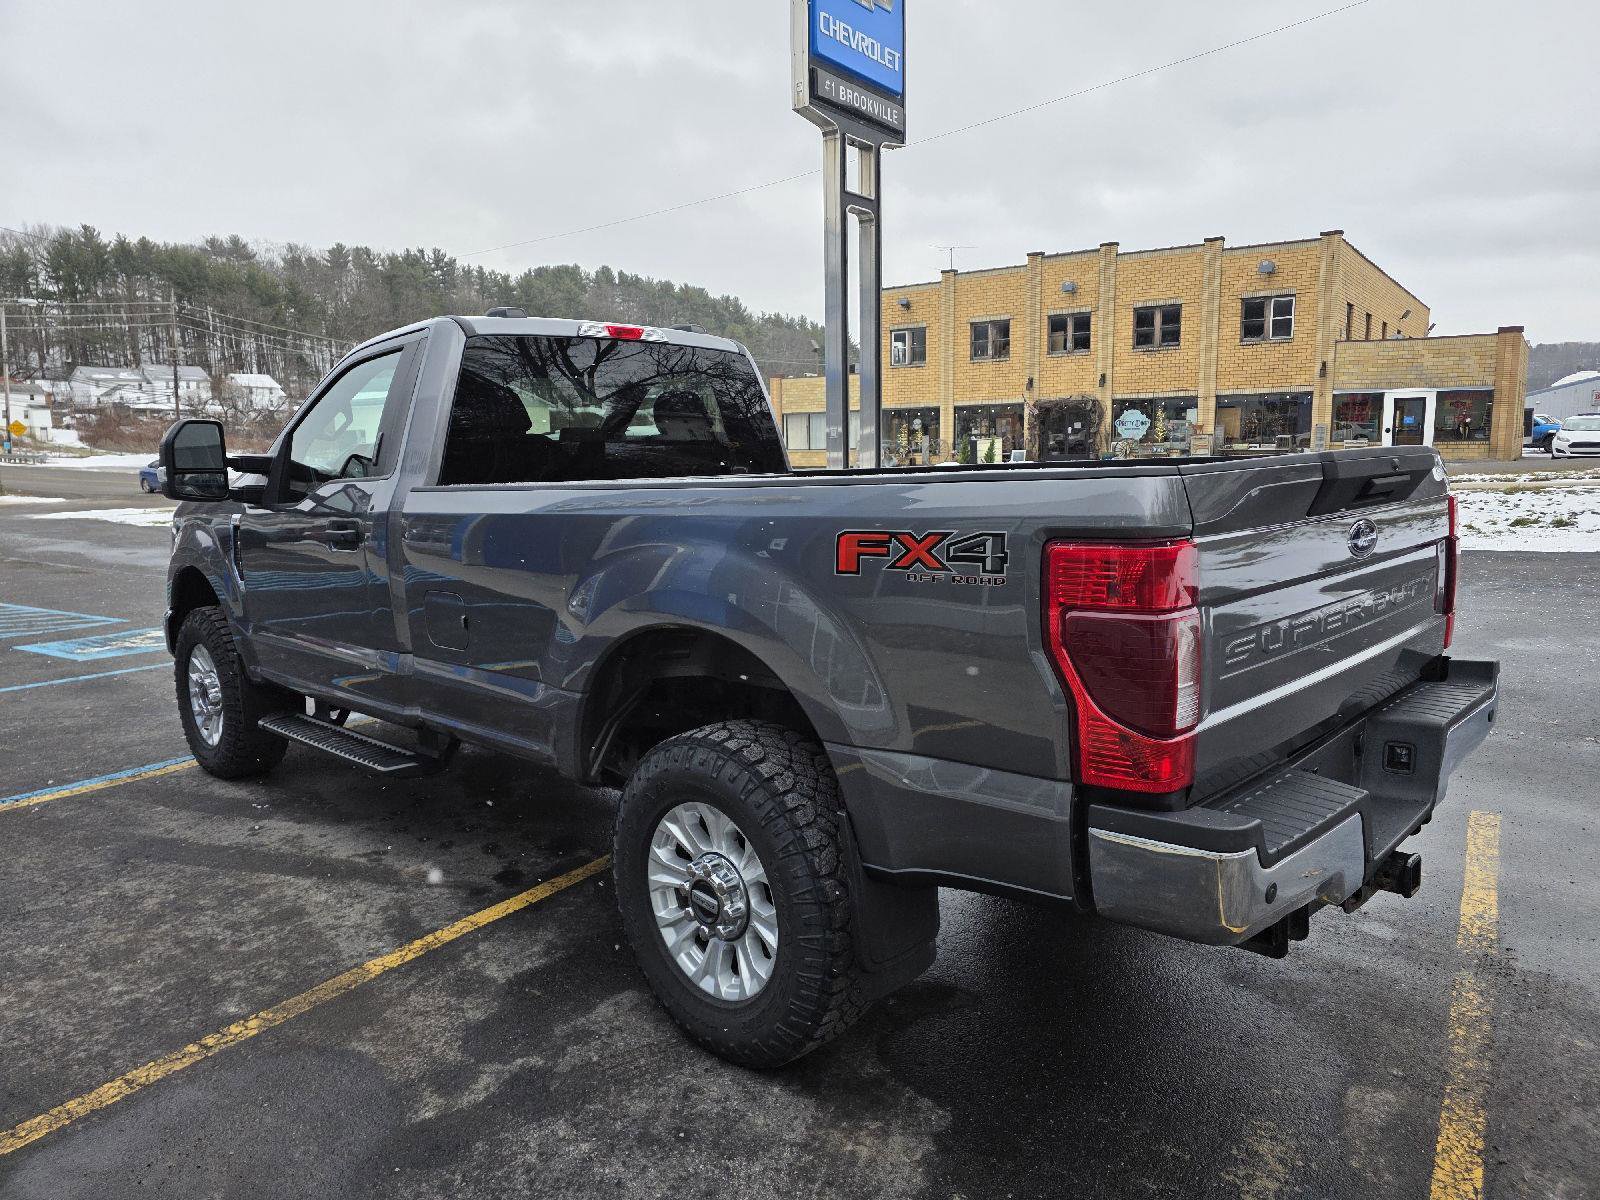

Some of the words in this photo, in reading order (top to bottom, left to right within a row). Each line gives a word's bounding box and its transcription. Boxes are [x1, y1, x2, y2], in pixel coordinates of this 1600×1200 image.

[819, 11, 900, 72] CHEVROLET
[839, 84, 899, 125] BROOKVILLE
[834, 529, 1010, 577] FX4
[905, 572, 945, 584] OFF
[951, 574, 1007, 587] ROAD
